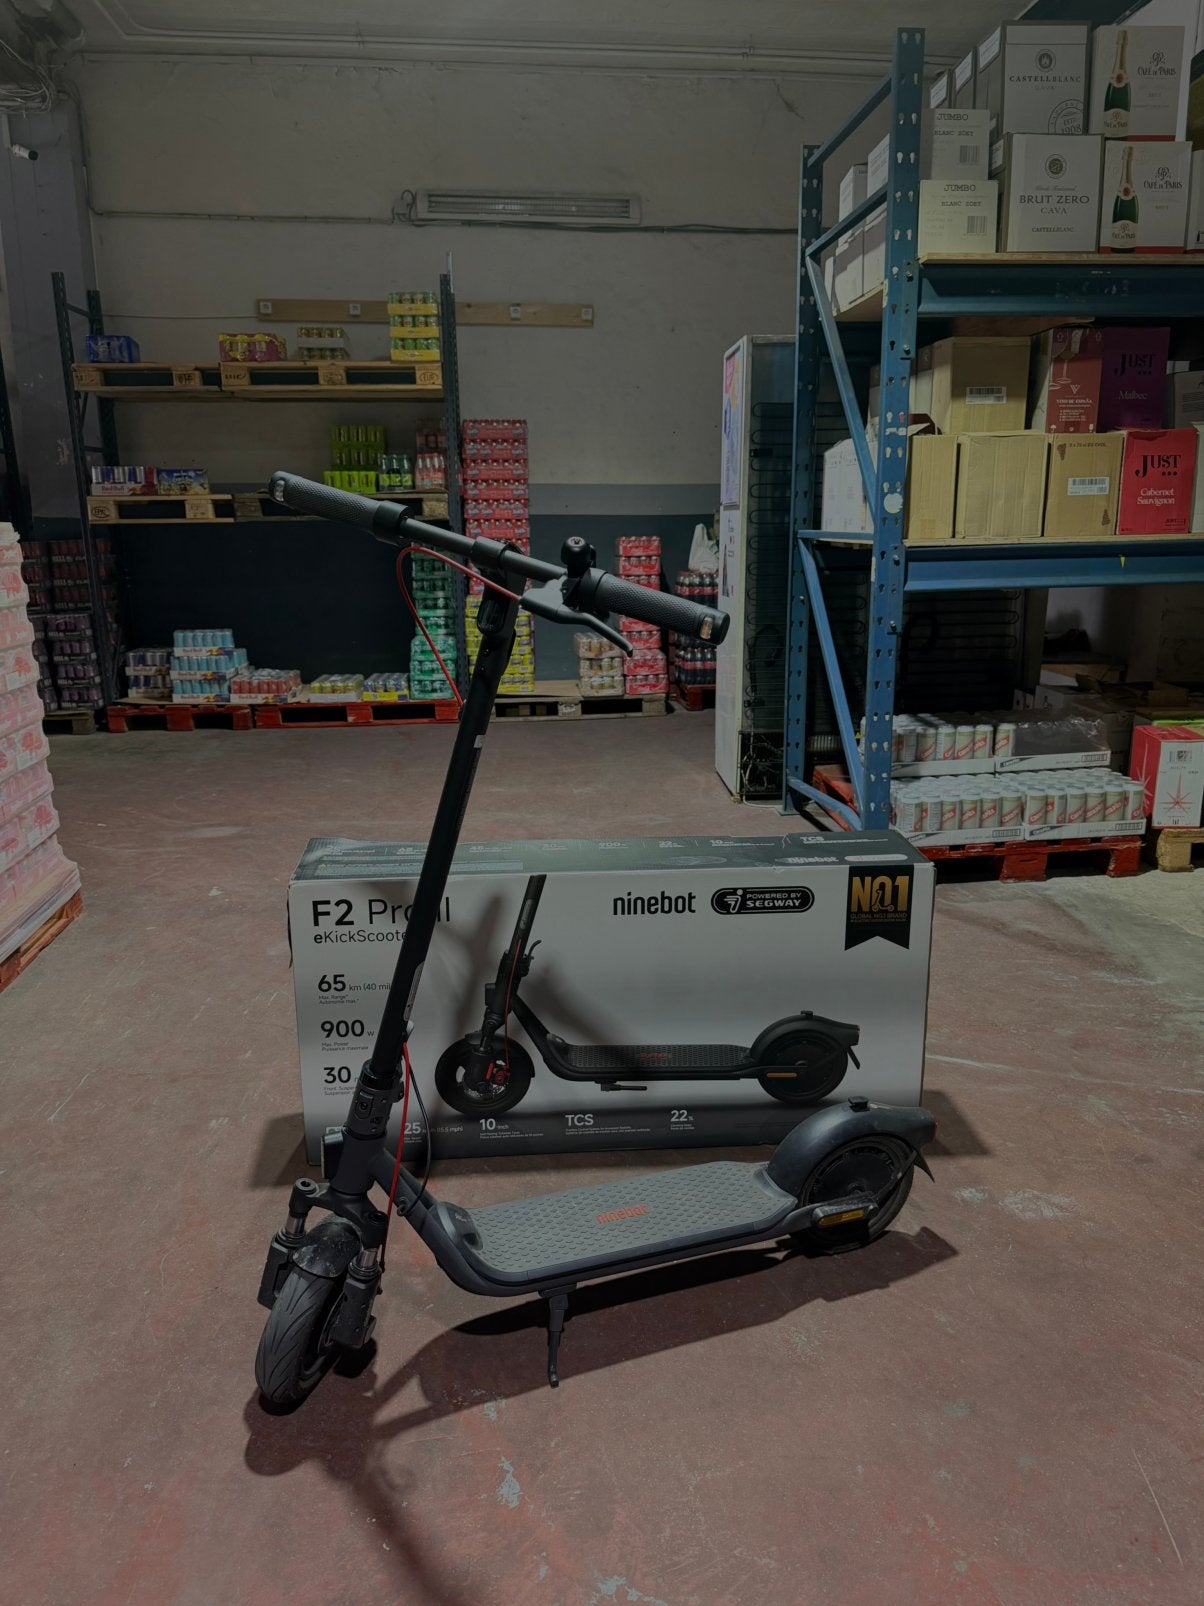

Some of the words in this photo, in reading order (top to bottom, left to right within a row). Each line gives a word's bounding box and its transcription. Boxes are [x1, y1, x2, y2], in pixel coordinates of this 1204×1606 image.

[1158, 66, 1177, 76] PARIS
[1009, 75, 1081, 83] CASTELLBLANC
[936, 113, 969, 121] JUMBO
[944, 184, 977, 192] JUMBO
[1164, 180, 1182, 190] PARIS
[1019, 195, 1053, 204] BRUT
[1056, 195, 1090, 204] ZERO
[1114, 353, 1156, 376] JUST
[1118, 390, 1148, 400] Malbec
[1134, 454, 1182, 478] JUST
[1140, 487, 1174, 497] Cabernet
[1136, 497, 1175, 507] Sauvignon
[613, 891, 696, 915] ninebot
[746, 899, 801, 908] SEGWAY
[312, 899, 355, 927] F2
[313, 929, 409, 944] eKickScoote
[318, 973, 346, 992] 65
[349, 983, 362, 991] km
[363, 983, 376, 991] (40
[320, 1019, 365, 1038] 900
[323, 1066, 351, 1084] 30
[564, 1113, 594, 1126] TCS
[404, 1121, 421, 1134] 25
